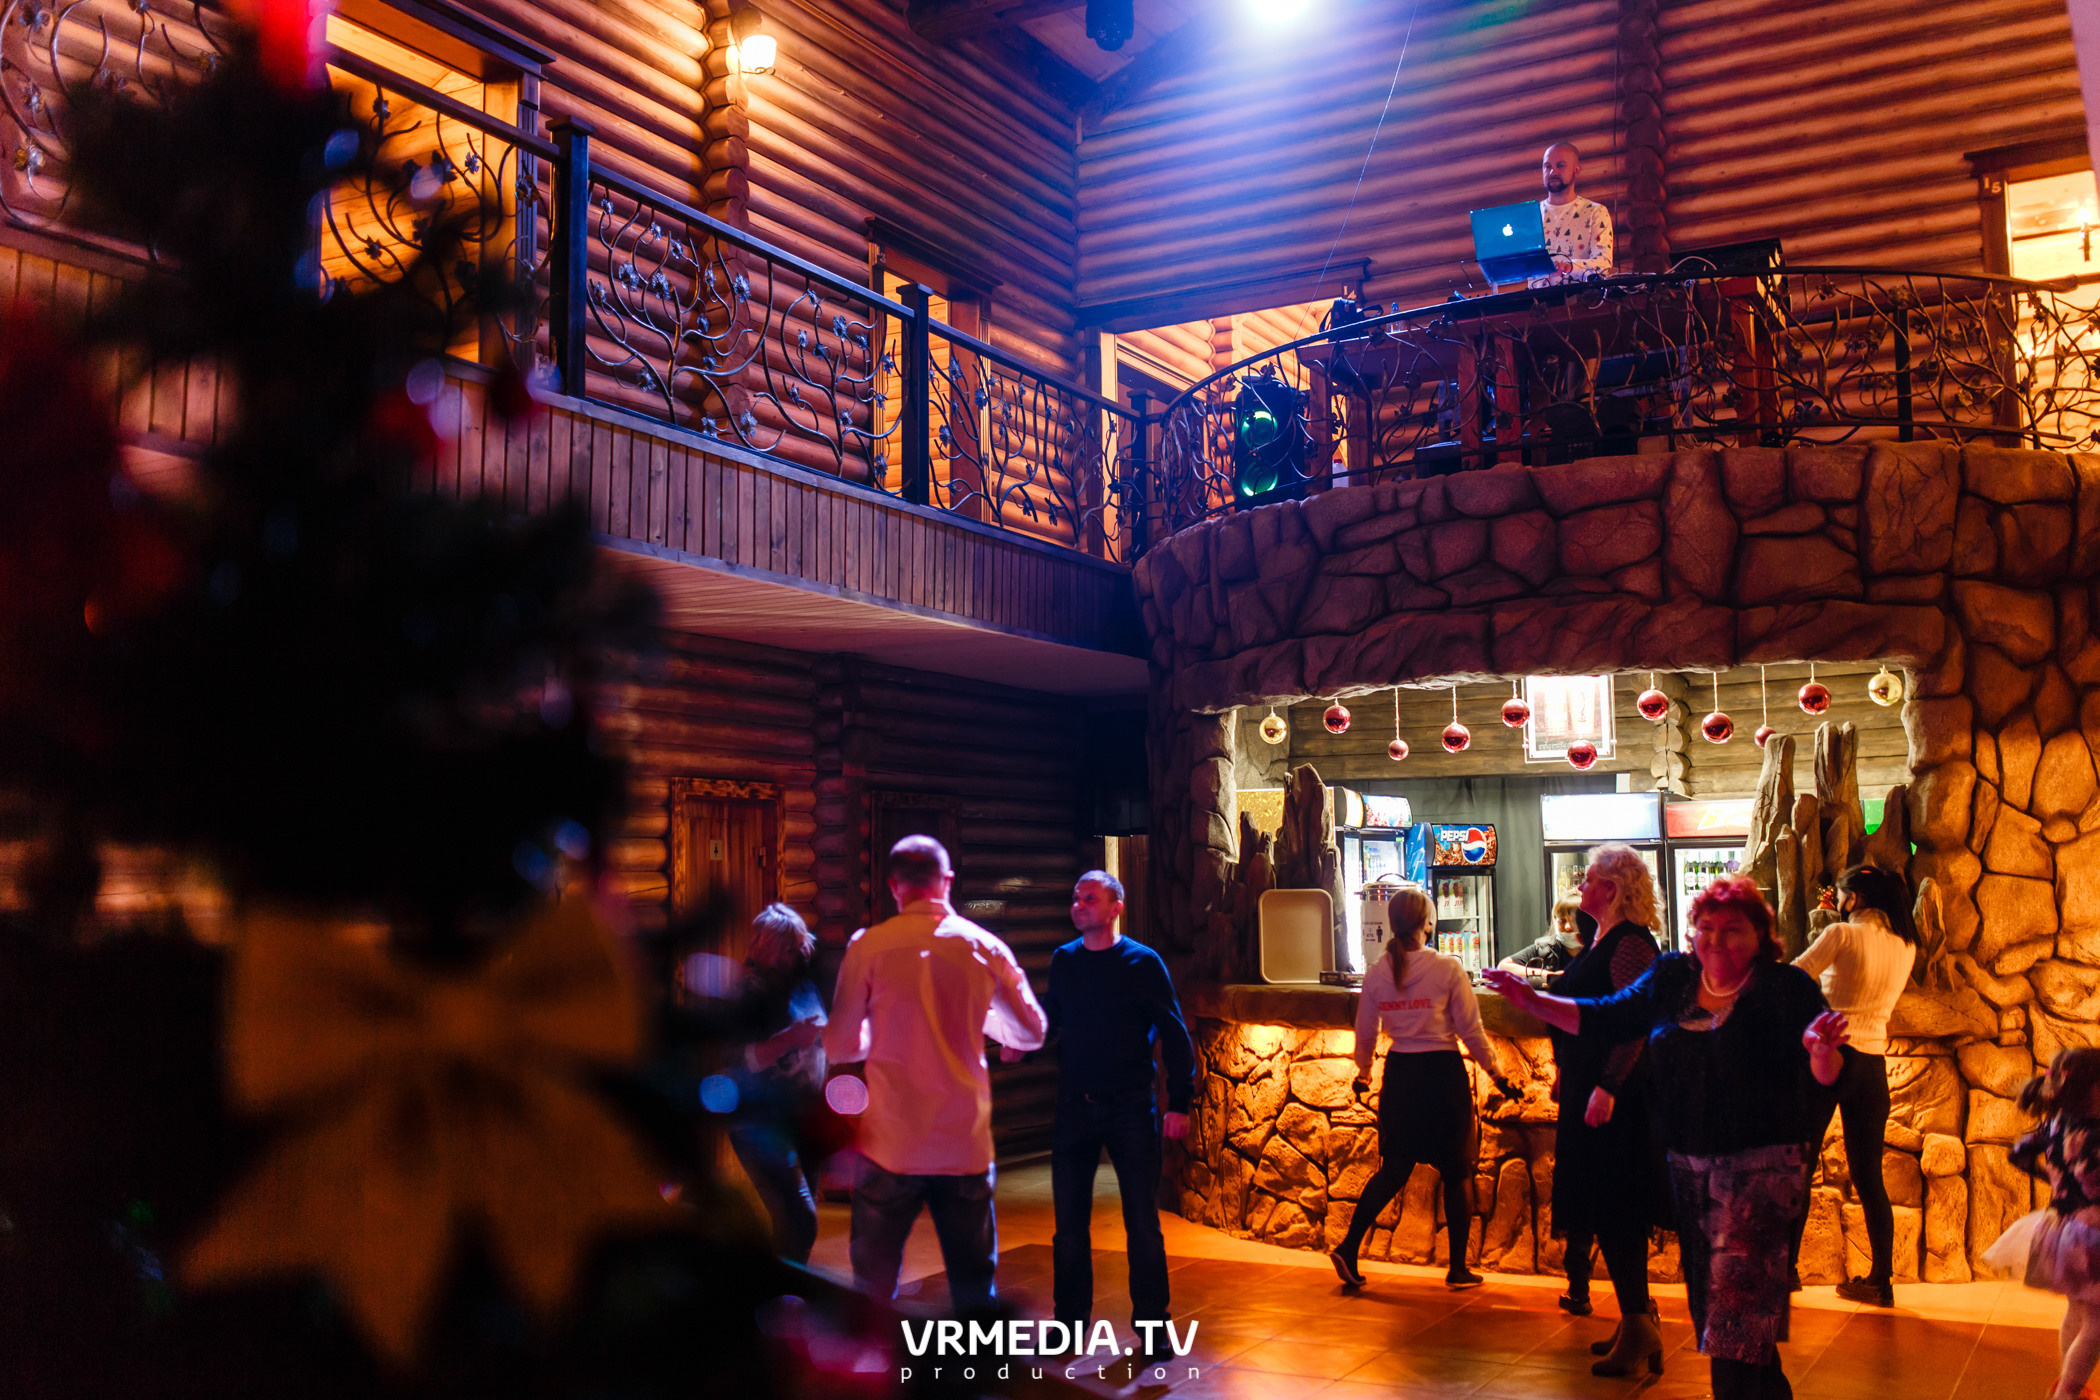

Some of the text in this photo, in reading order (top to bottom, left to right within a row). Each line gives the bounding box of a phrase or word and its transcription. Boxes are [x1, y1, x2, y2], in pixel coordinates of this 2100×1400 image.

[1984, 177, 2002, 193] 15
[1440, 829, 1470, 842] PEPSI
[1408, 998, 1432, 1010] LOVE
